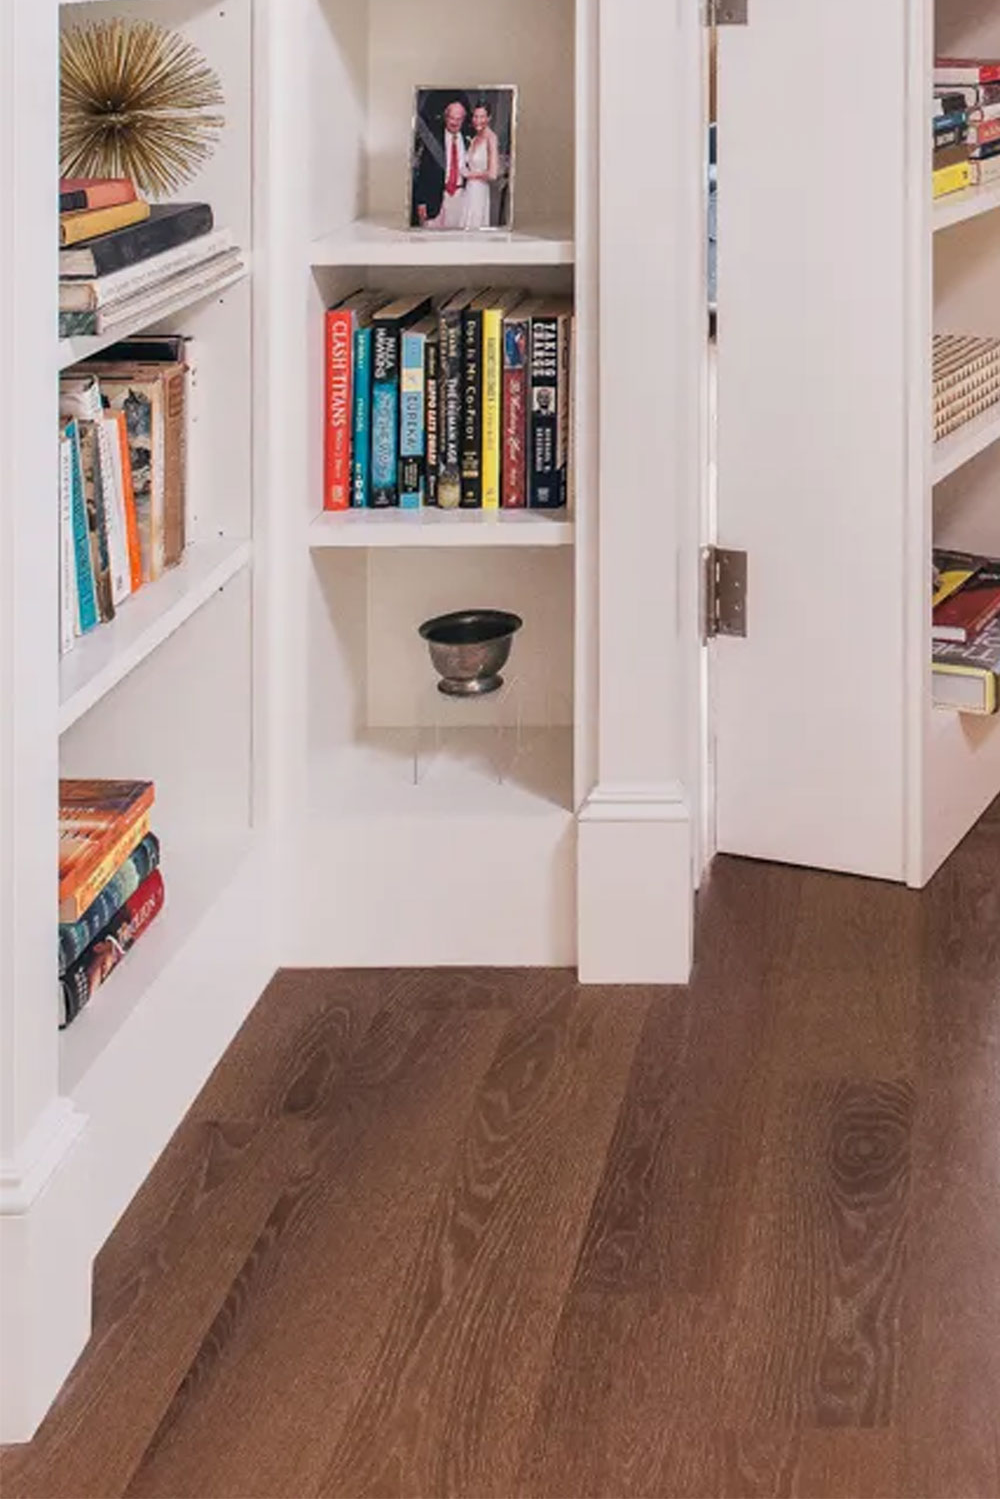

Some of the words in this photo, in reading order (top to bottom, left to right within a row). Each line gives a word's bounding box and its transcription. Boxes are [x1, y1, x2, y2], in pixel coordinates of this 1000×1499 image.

[332, 321, 347, 369] CLASH
[375, 328, 386, 379] HAWKINS
[386, 337, 395, 369] PAULA
[531, 322, 544, 378] CHARGE
[543, 322, 556, 378] TAKING
[332, 375, 347, 427] TITANS
[447, 378, 457, 399] THE
[447, 400, 457, 441] HUMAN
[447, 443, 457, 463] AGE
